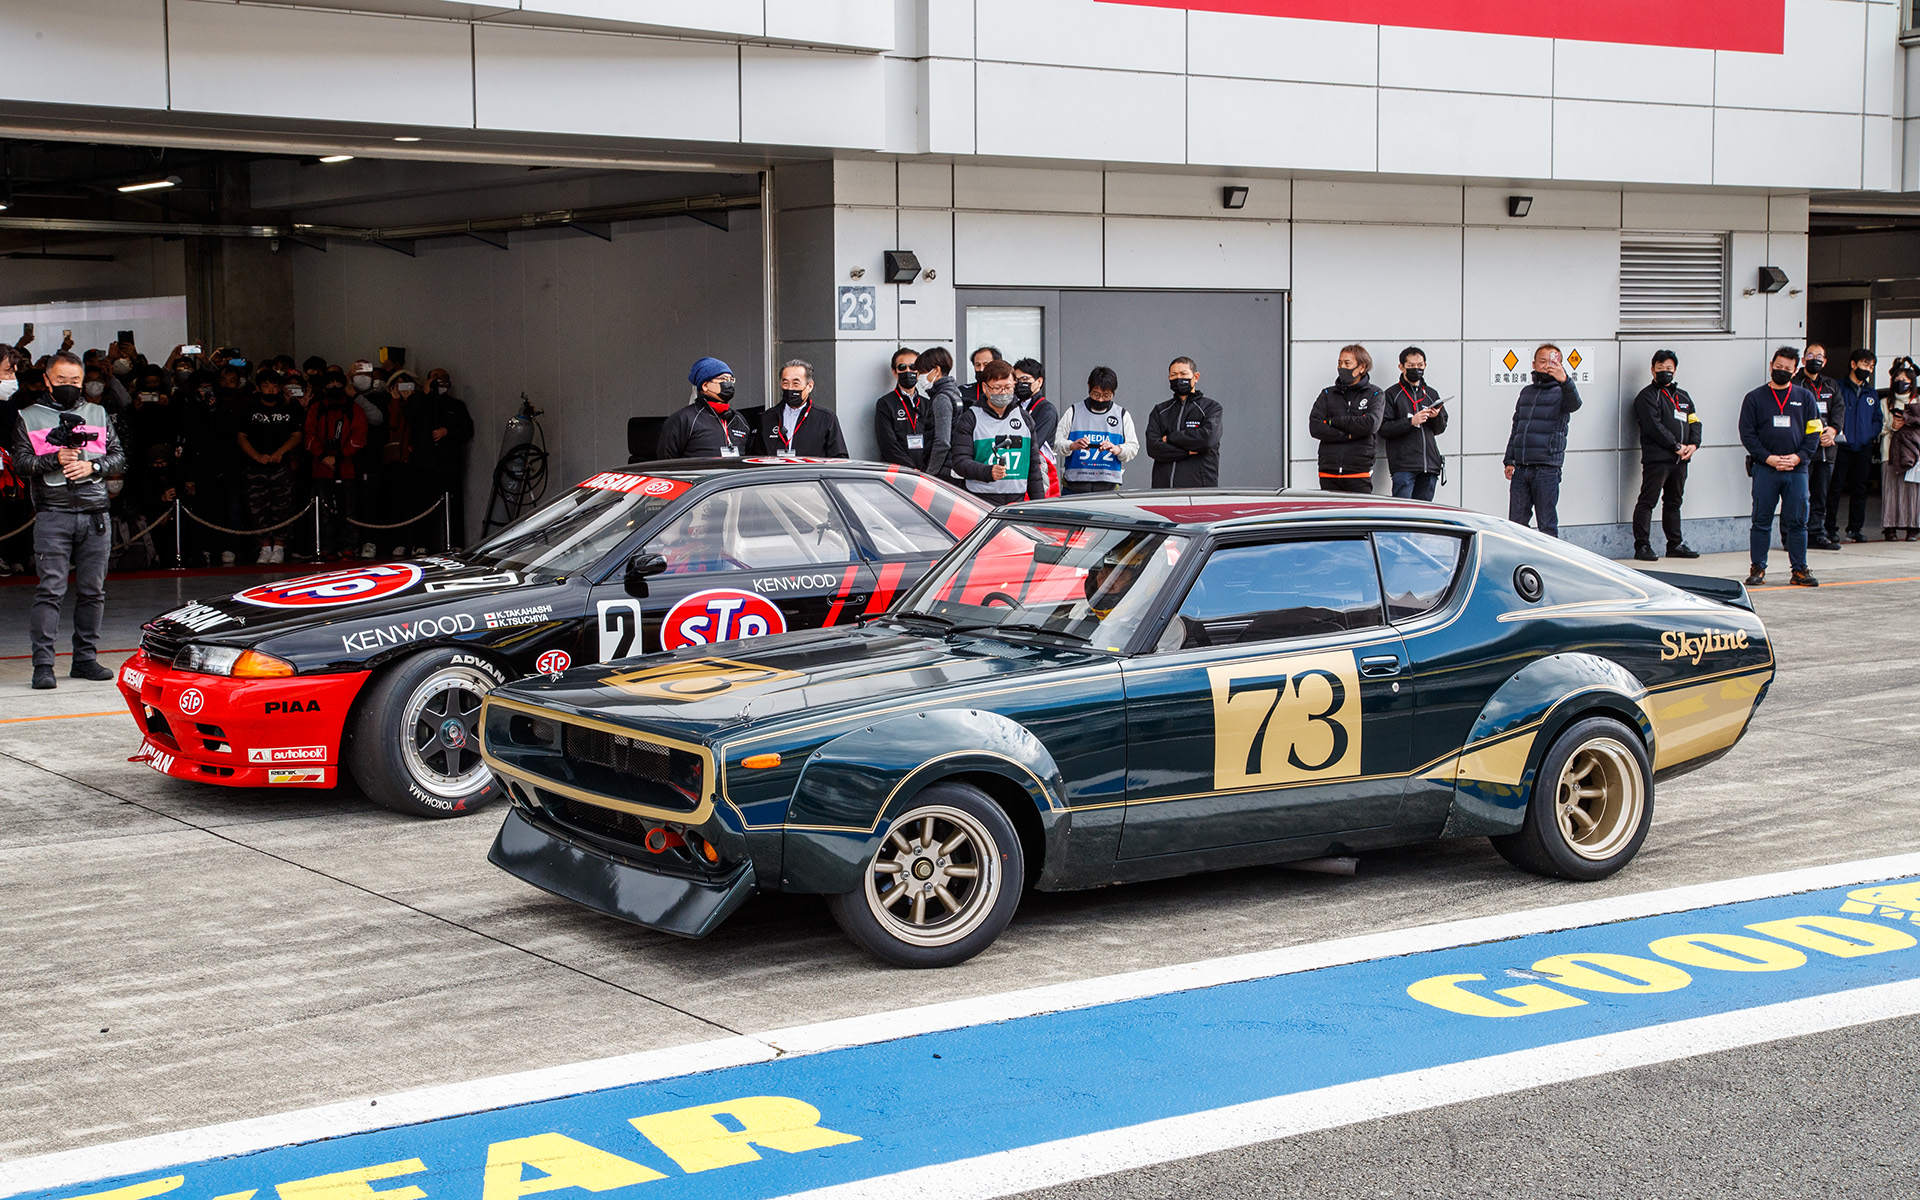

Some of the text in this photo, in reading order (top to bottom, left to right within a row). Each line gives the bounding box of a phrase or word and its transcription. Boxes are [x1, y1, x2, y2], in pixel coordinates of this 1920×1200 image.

[841, 293, 873, 324] 23
[1495, 373, 1527, 383] 変電設備
[1571, 372, 1589, 382] 電圧
[1083, 433, 1111, 443] MEDIA
[647, 481, 668, 493] STP
[753, 574, 837, 592] KENWOOD
[496, 605, 552, 619] K.TAKAHASHI
[499, 613, 549, 627] K.TSUCHIYA
[342, 613, 475, 654] KENWOOD
[605, 606, 635, 660] 2
[1661, 628, 1750, 666] Skyline
[450, 654, 506, 684] ADVAN
[540, 652, 567, 673] STP
[181, 691, 201, 711] STP
[265, 700, 321, 714] PIAA
[1227, 669, 1349, 776] 73
[274, 748, 325, 760] autolook
[408, 782, 453, 810] YOKOHAMA
[1406, 915, 1918, 1018] GOOD
